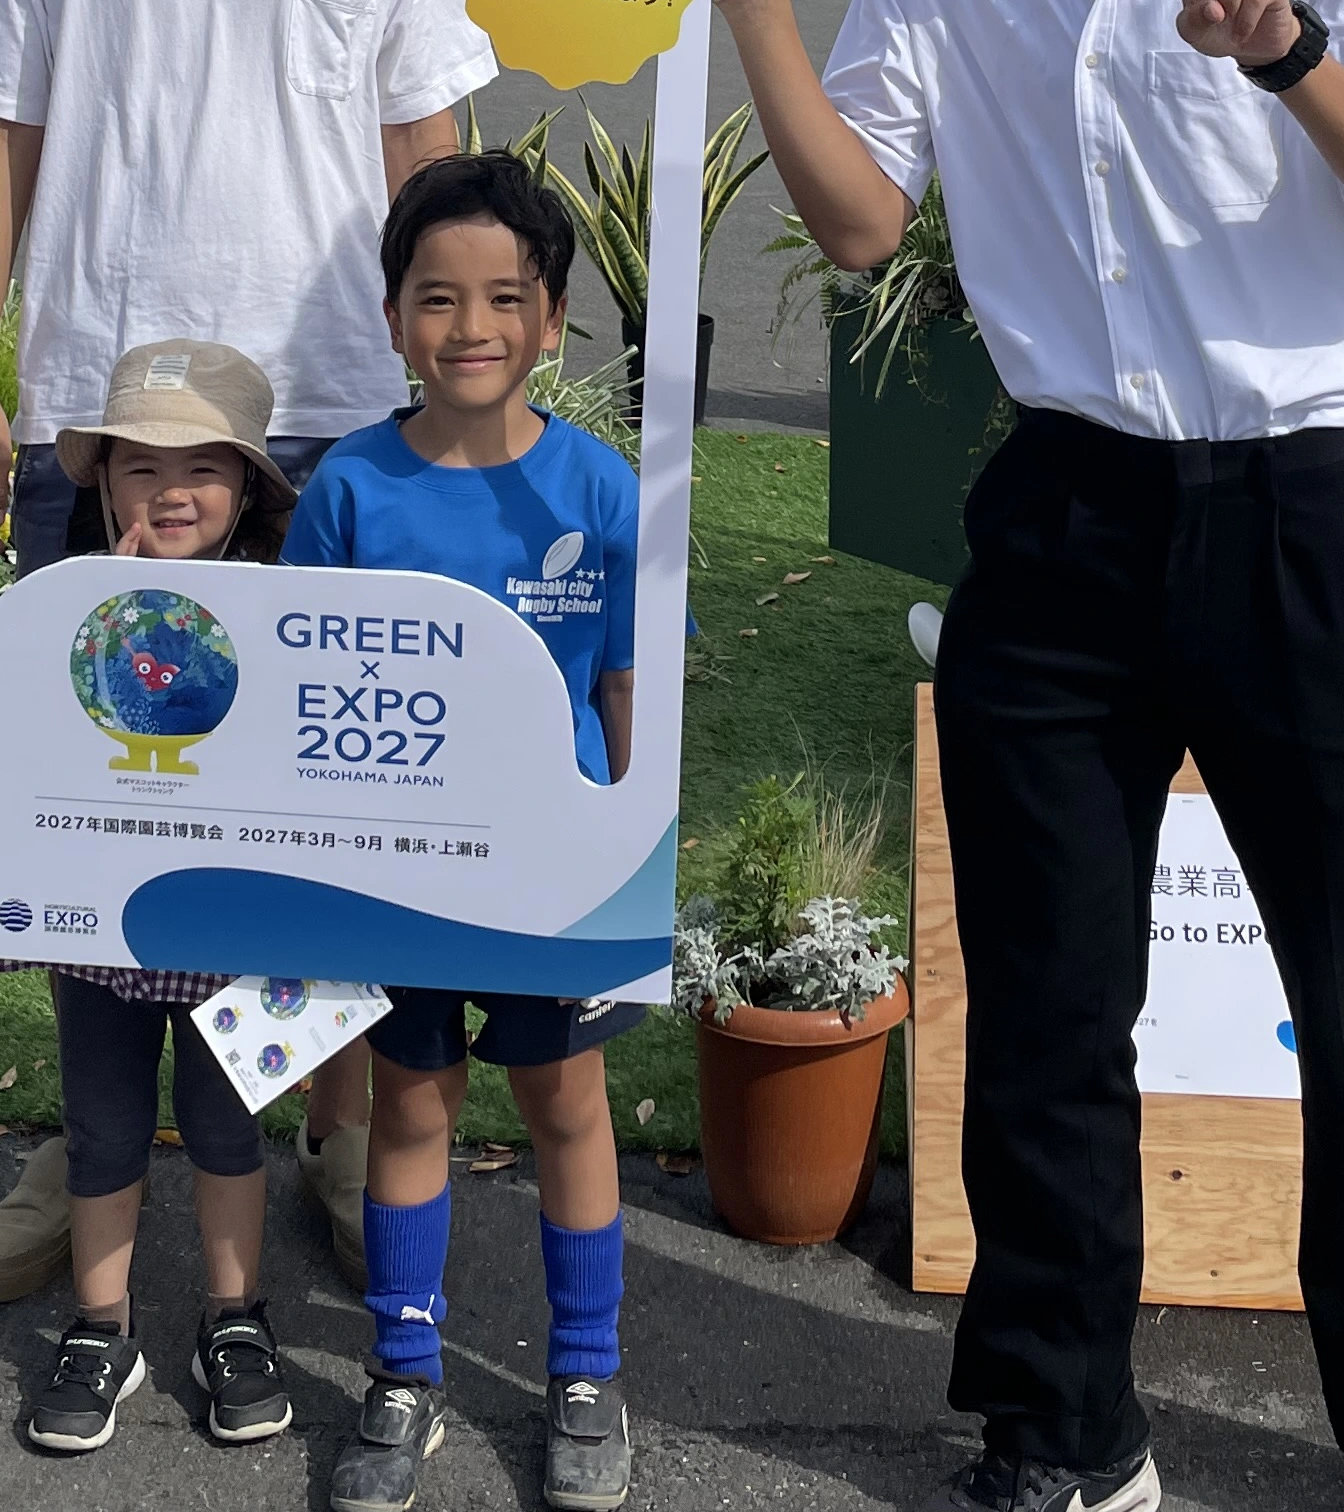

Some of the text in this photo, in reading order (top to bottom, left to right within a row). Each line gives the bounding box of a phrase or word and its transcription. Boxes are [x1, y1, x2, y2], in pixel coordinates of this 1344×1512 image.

[506, 576, 567, 596] Kawasaki
[517, 596, 603, 614] Rugby School
[276, 612, 464, 658] GREEN
[298, 683, 447, 726] EXPO
[297, 725, 446, 767] 2027
[296, 767, 444, 787] YOKOHAMA JAPAN
[35, 814, 224, 841] 2027年国際園芸博覧会
[1151, 864, 1252, 899] 農業高
[44, 910, 98, 928] EXPO
[1182, 923, 1208, 943] to
[1217, 923, 1271, 945] EXP
